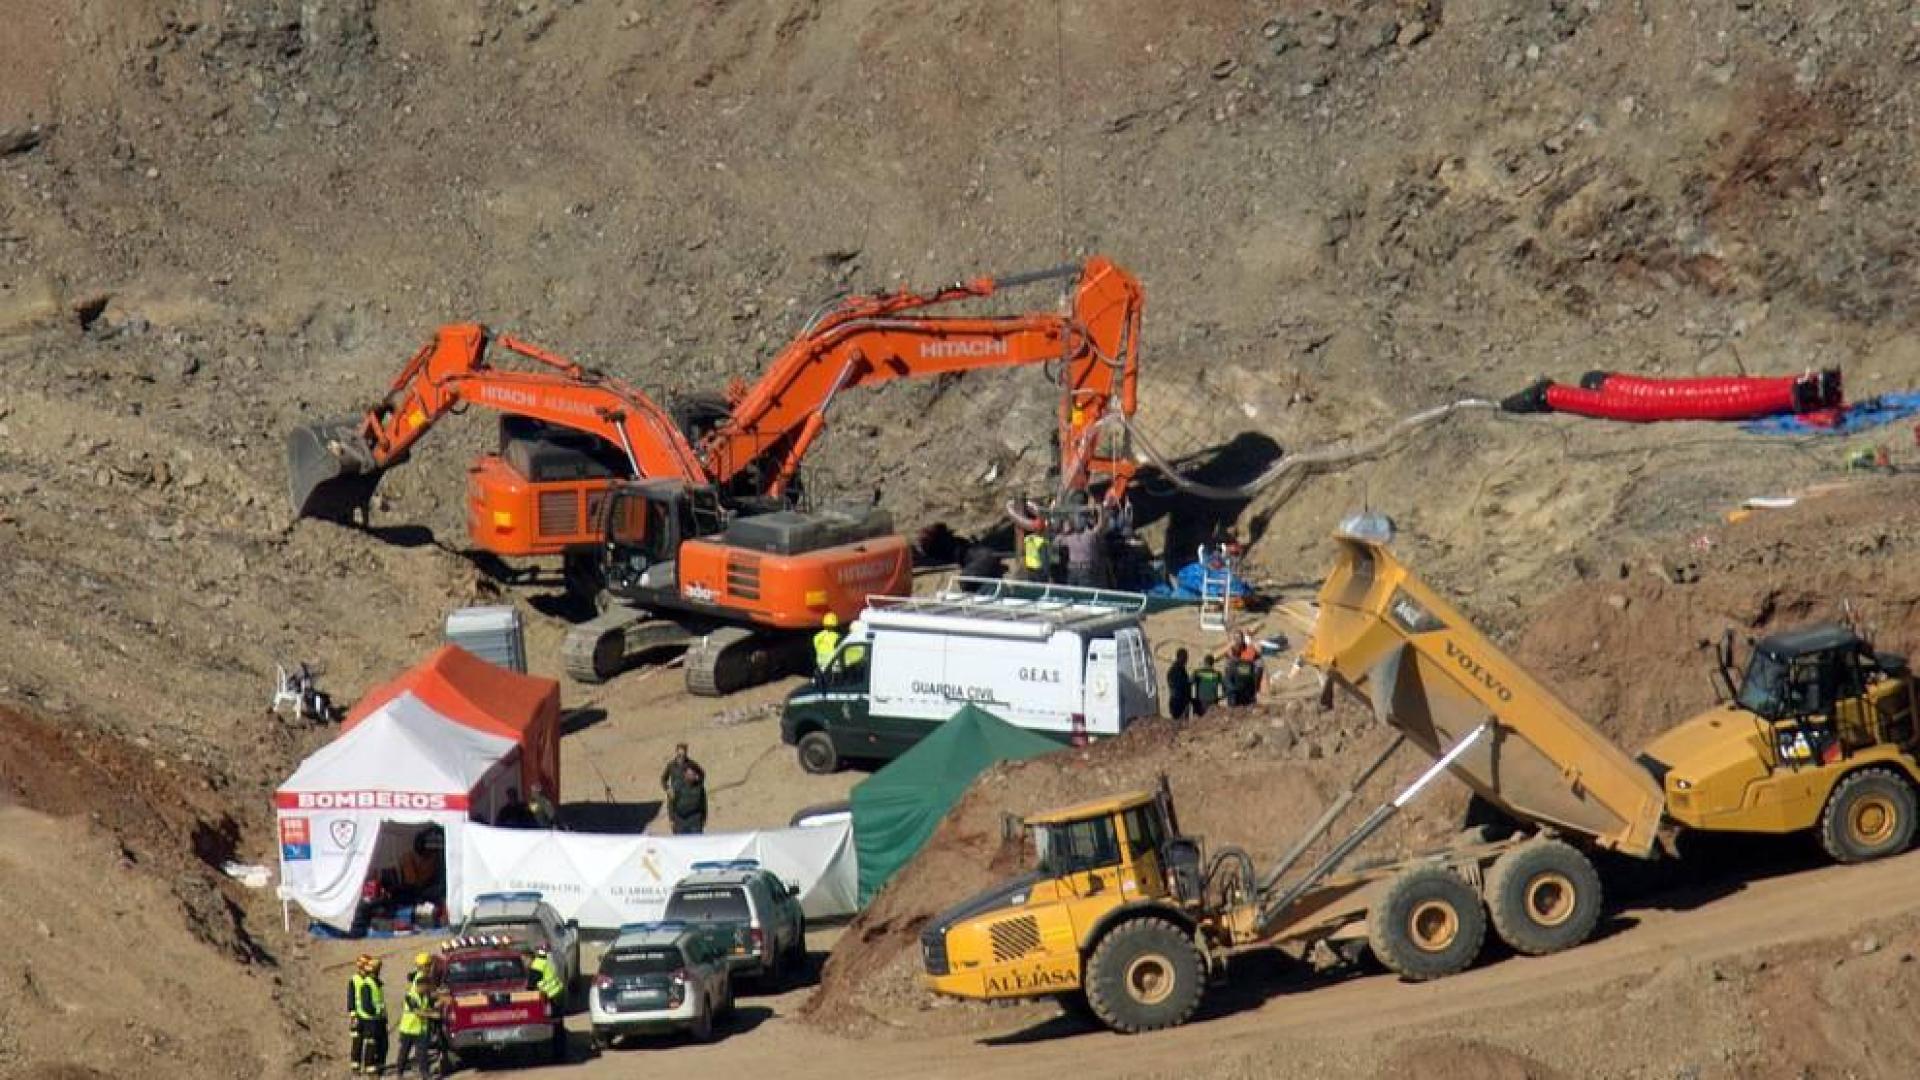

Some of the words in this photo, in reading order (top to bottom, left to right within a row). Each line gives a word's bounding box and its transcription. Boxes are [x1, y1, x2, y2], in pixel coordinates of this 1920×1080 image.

[919, 337, 1008, 358] HITACHI
[480, 385, 537, 407] HITACHI
[1446, 639, 1513, 701] VOLVO
[911, 680, 964, 699] GUARDIA
[966, 685, 995, 702] CIVIL
[298, 791, 446, 809] BOMBEROS
[986, 964, 1078, 991] ALEJASA
